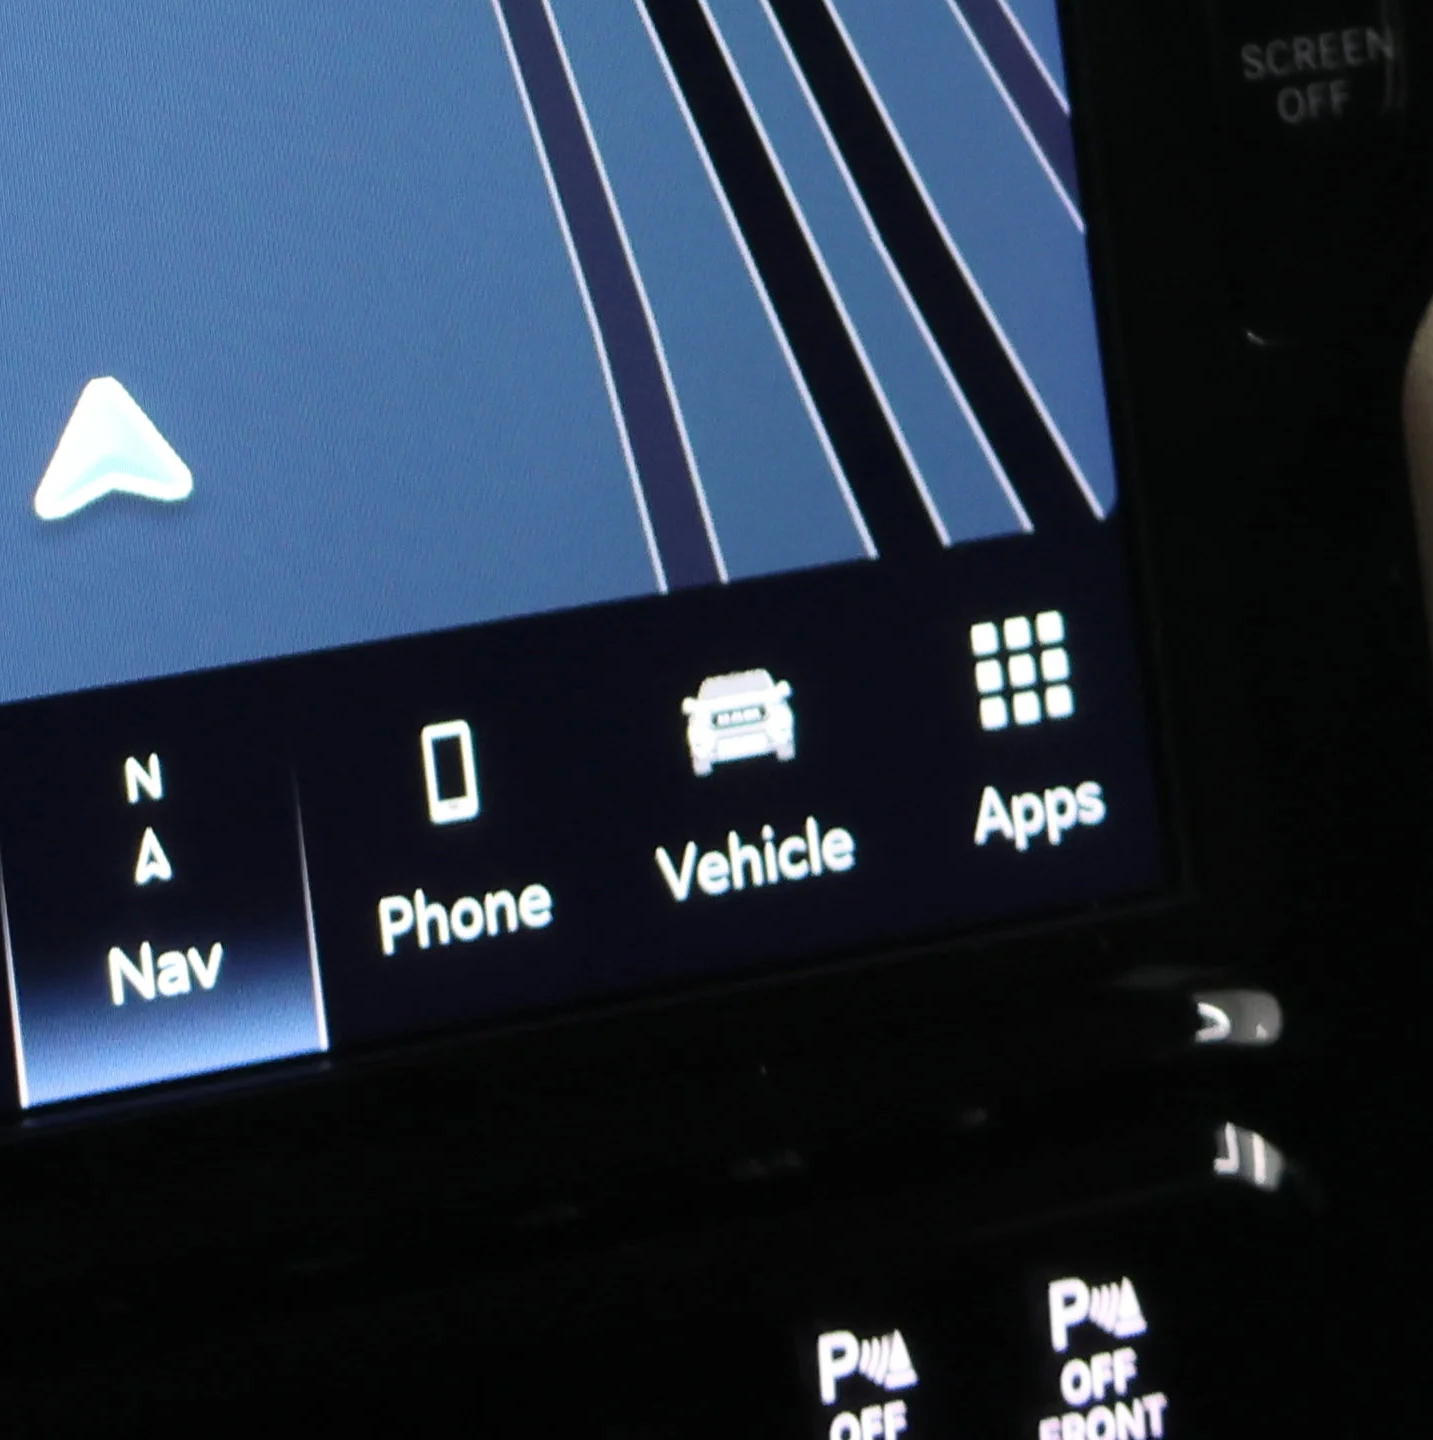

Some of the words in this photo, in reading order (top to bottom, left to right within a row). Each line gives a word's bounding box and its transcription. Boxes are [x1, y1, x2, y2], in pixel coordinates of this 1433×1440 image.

[1240, 26, 1395, 81] SCREEN
[1276, 80, 1350, 125] OFF
[123, 751, 164, 805] N
[973, 780, 1107, 852] Apps
[654, 815, 855, 902] Vehicle
[377, 883, 553, 956] Phone
[107, 940, 224, 1007] Nav
[1059, 1346, 1139, 1407] OFF
[829, 1399, 908, 1440] OFF
